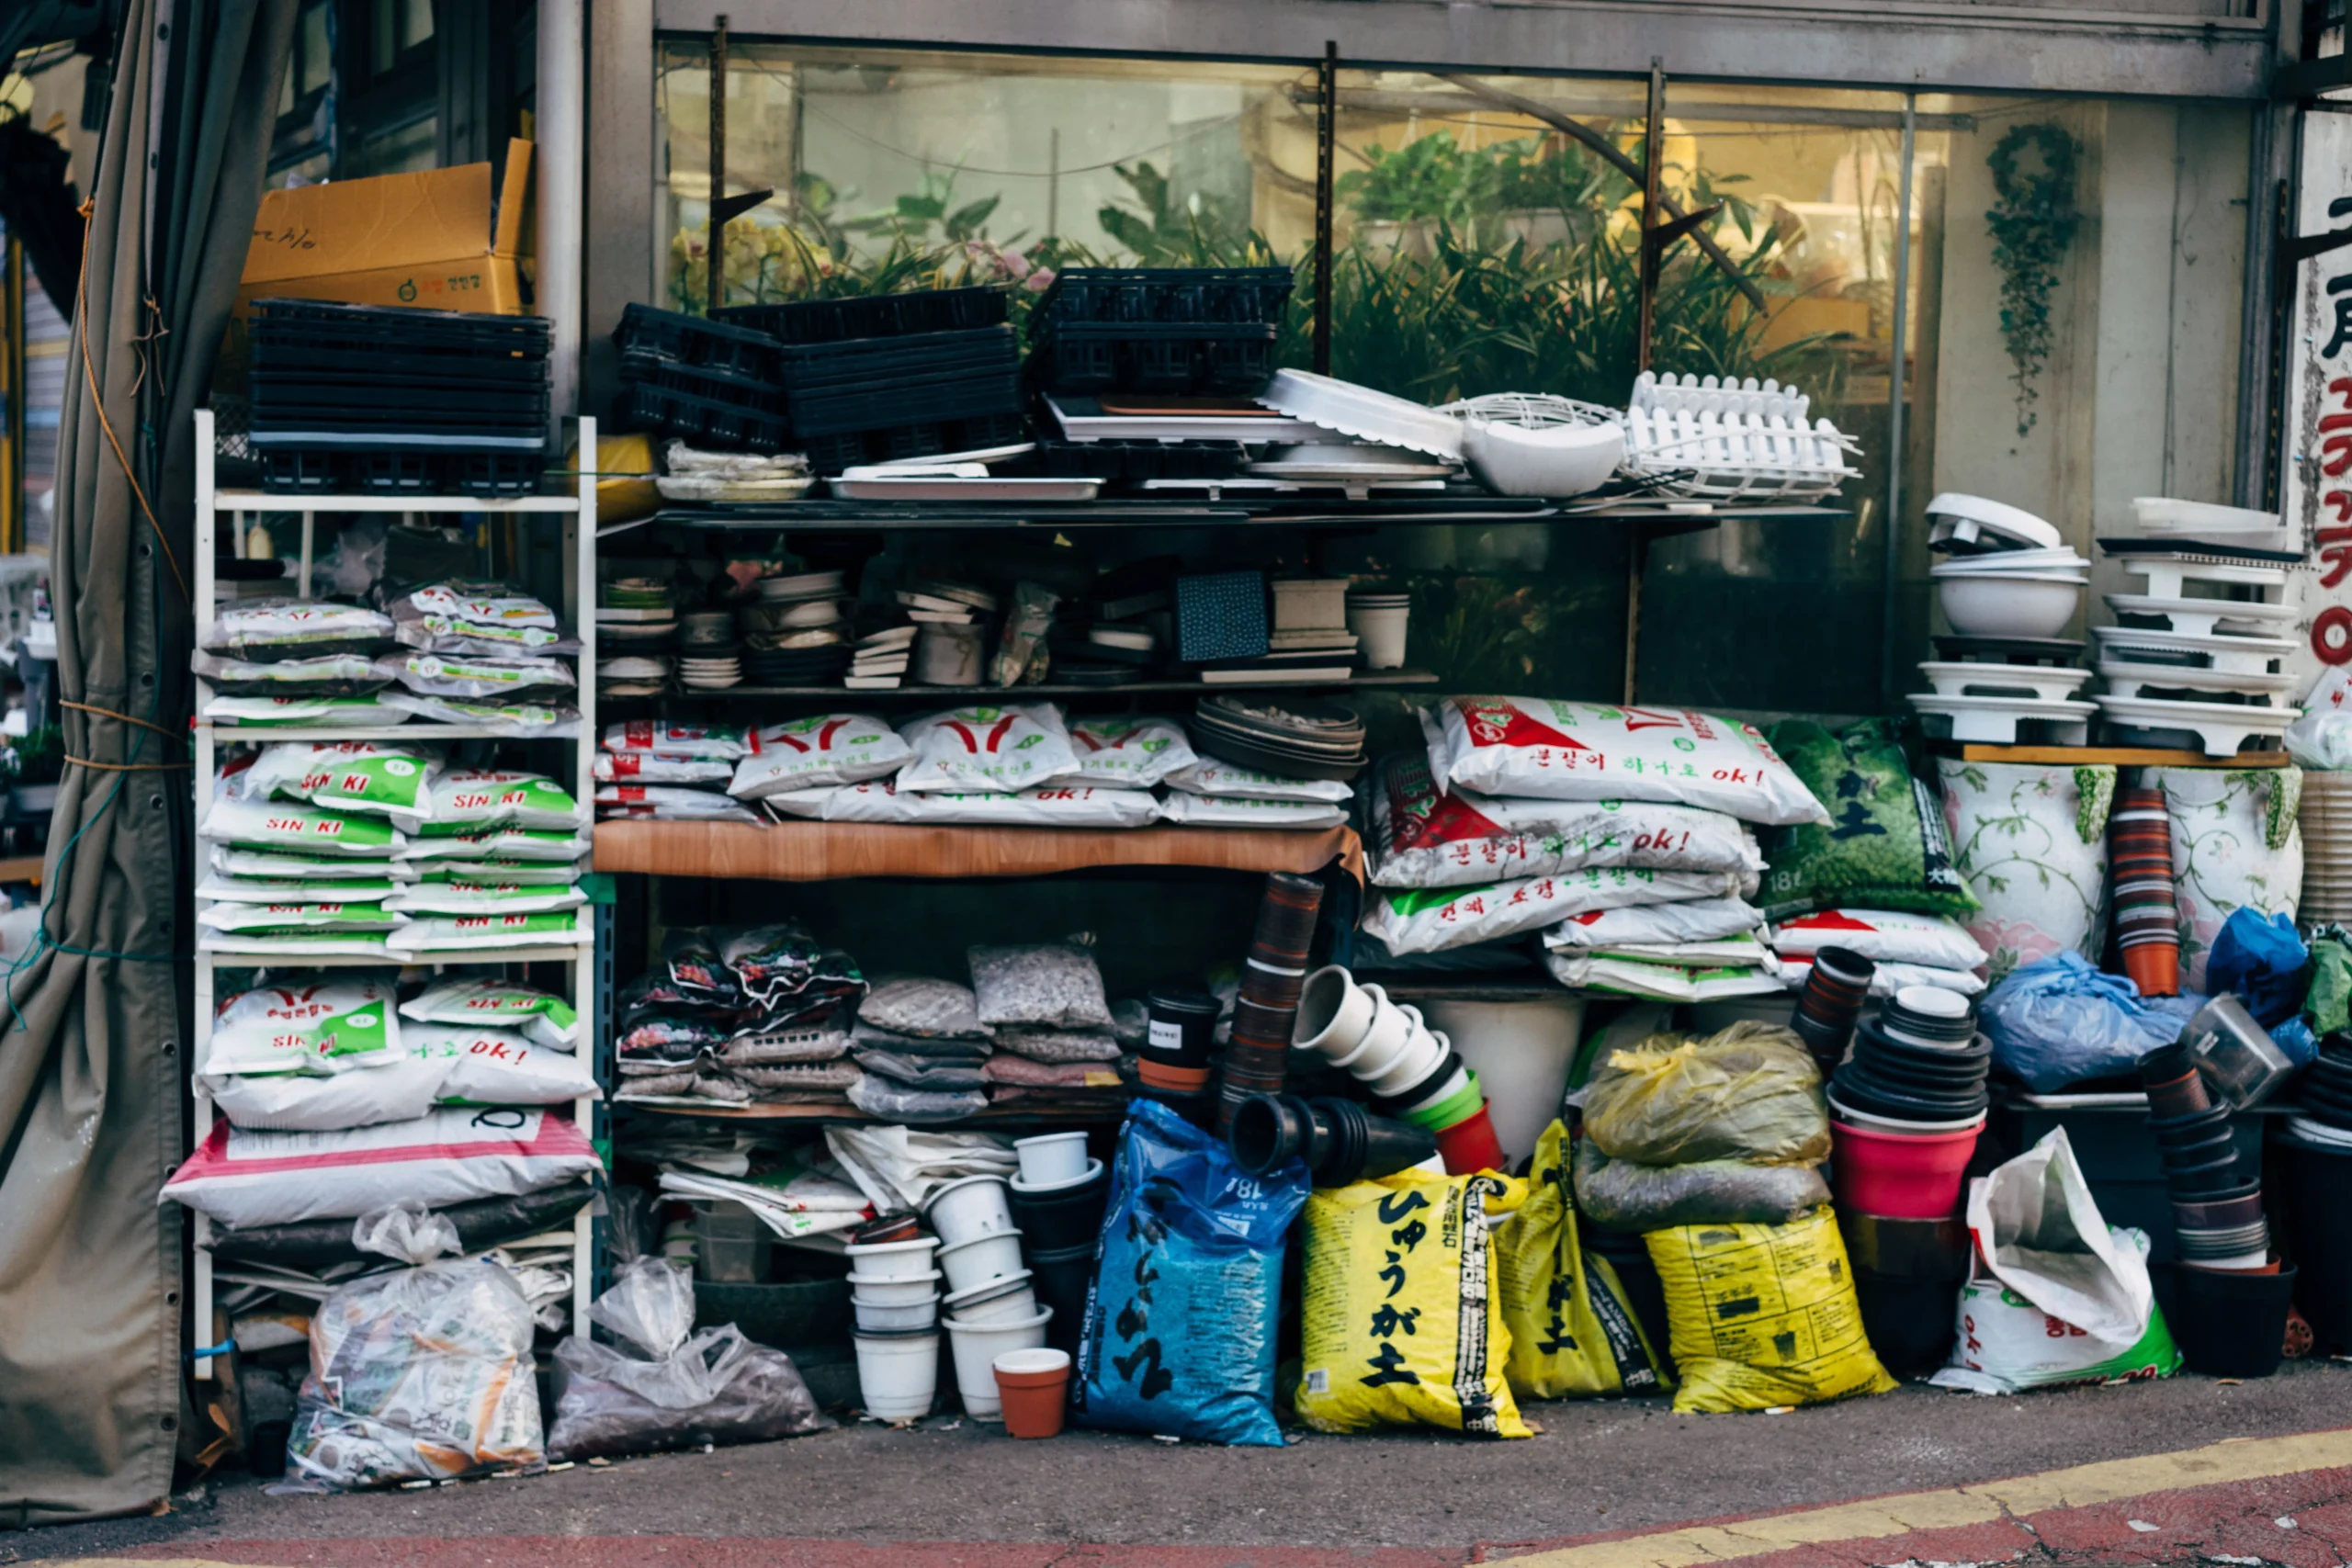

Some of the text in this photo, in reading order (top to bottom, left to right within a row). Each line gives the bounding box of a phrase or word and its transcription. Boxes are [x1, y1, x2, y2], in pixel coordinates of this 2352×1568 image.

[301, 773, 368, 792] SIN KI
[454, 792, 526, 808] SIN KI
[266, 818, 342, 833] SIN KI
[1360, 1190, 1431, 1388] ひゅうが土
